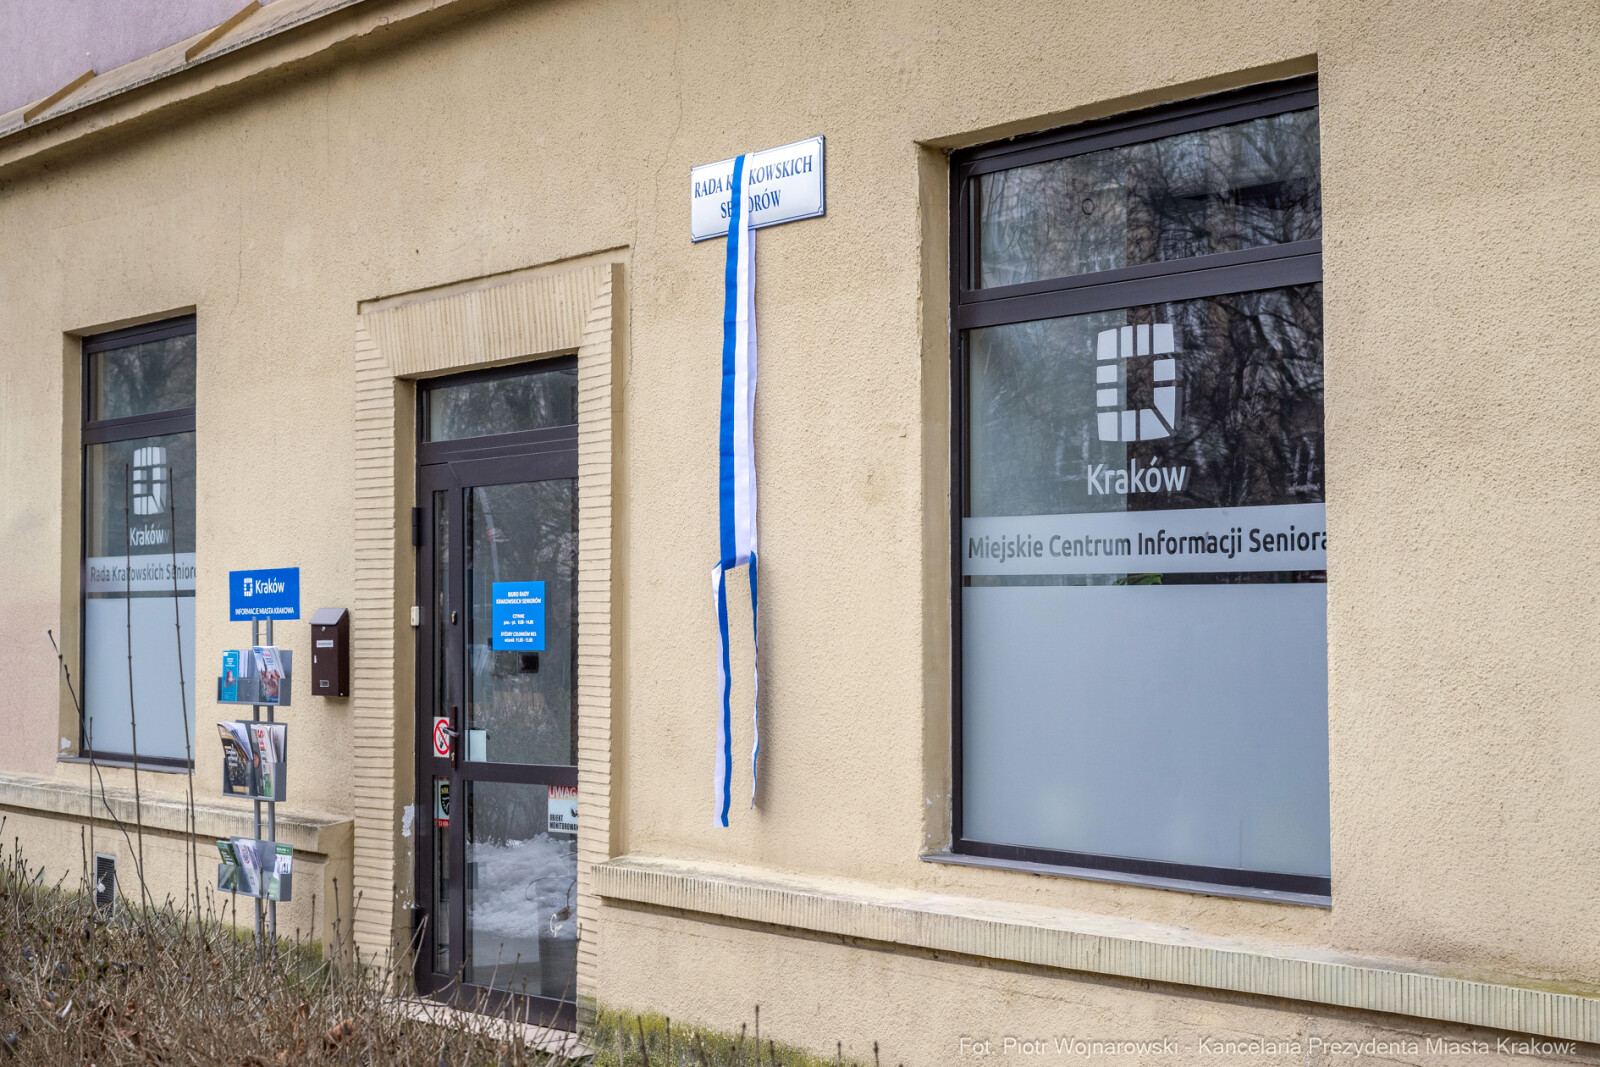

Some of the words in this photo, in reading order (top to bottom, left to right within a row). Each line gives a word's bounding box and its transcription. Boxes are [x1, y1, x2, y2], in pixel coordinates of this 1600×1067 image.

[694, 177, 723, 199] RADA
[726, 155, 813, 191] KKOWSKICH
[1087, 456, 1187, 496] Kraków
[129, 523, 165, 546] Kraków
[968, 534, 1044, 564] Miejskie
[1049, 534, 1131, 558] Centrum
[1138, 527, 1242, 559] Informacji
[91, 565, 110, 582] Rada
[255, 577, 285, 594] Kraków
